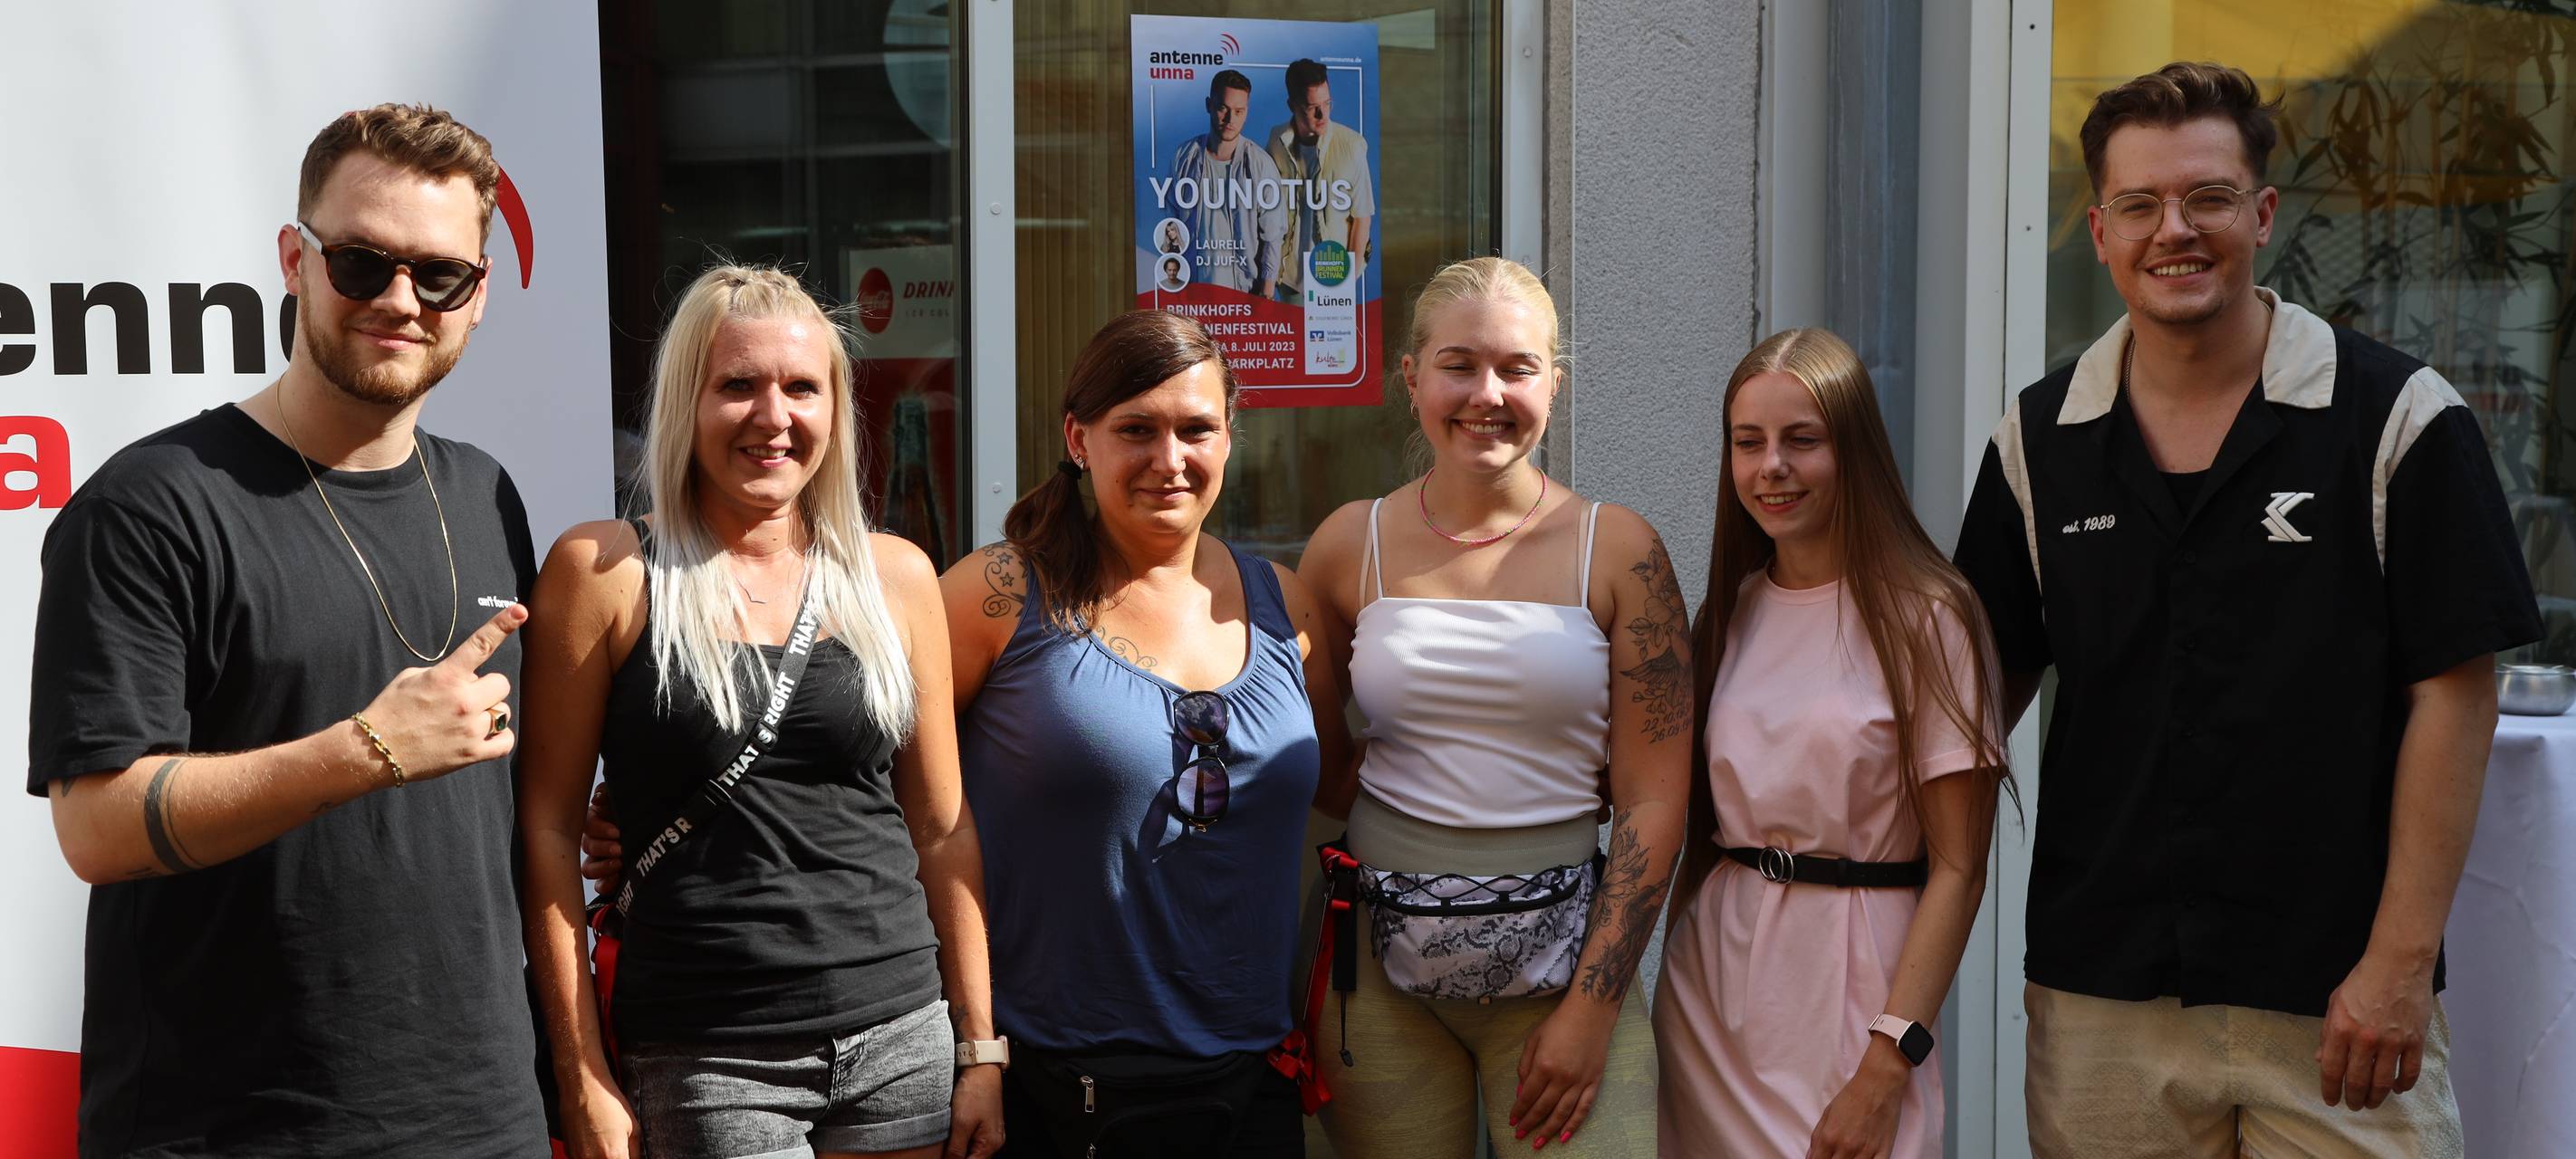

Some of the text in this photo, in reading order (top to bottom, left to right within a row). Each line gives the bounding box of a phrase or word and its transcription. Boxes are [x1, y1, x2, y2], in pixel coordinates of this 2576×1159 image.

[1149, 49, 1224, 66] antenne
[1149, 67, 1195, 81] unna
[1149, 177, 1353, 212] YOUNOTUS
[1196, 239, 1246, 250] LAURELL
[1196, 255, 1247, 266] DJ JUF-X
[1317, 296, 1352, 306] Lünen
[1167, 304, 1252, 316] BRINKHOFFS
[1231, 342, 1240, 351] 8.
[1243, 342, 1266, 351] JULI
[1269, 341, 1295, 351] 2023
[2084, 514, 2116, 532] 1989
[764, 672, 796, 727] RIGHT
[636, 827, 680, 877] THAT'S
